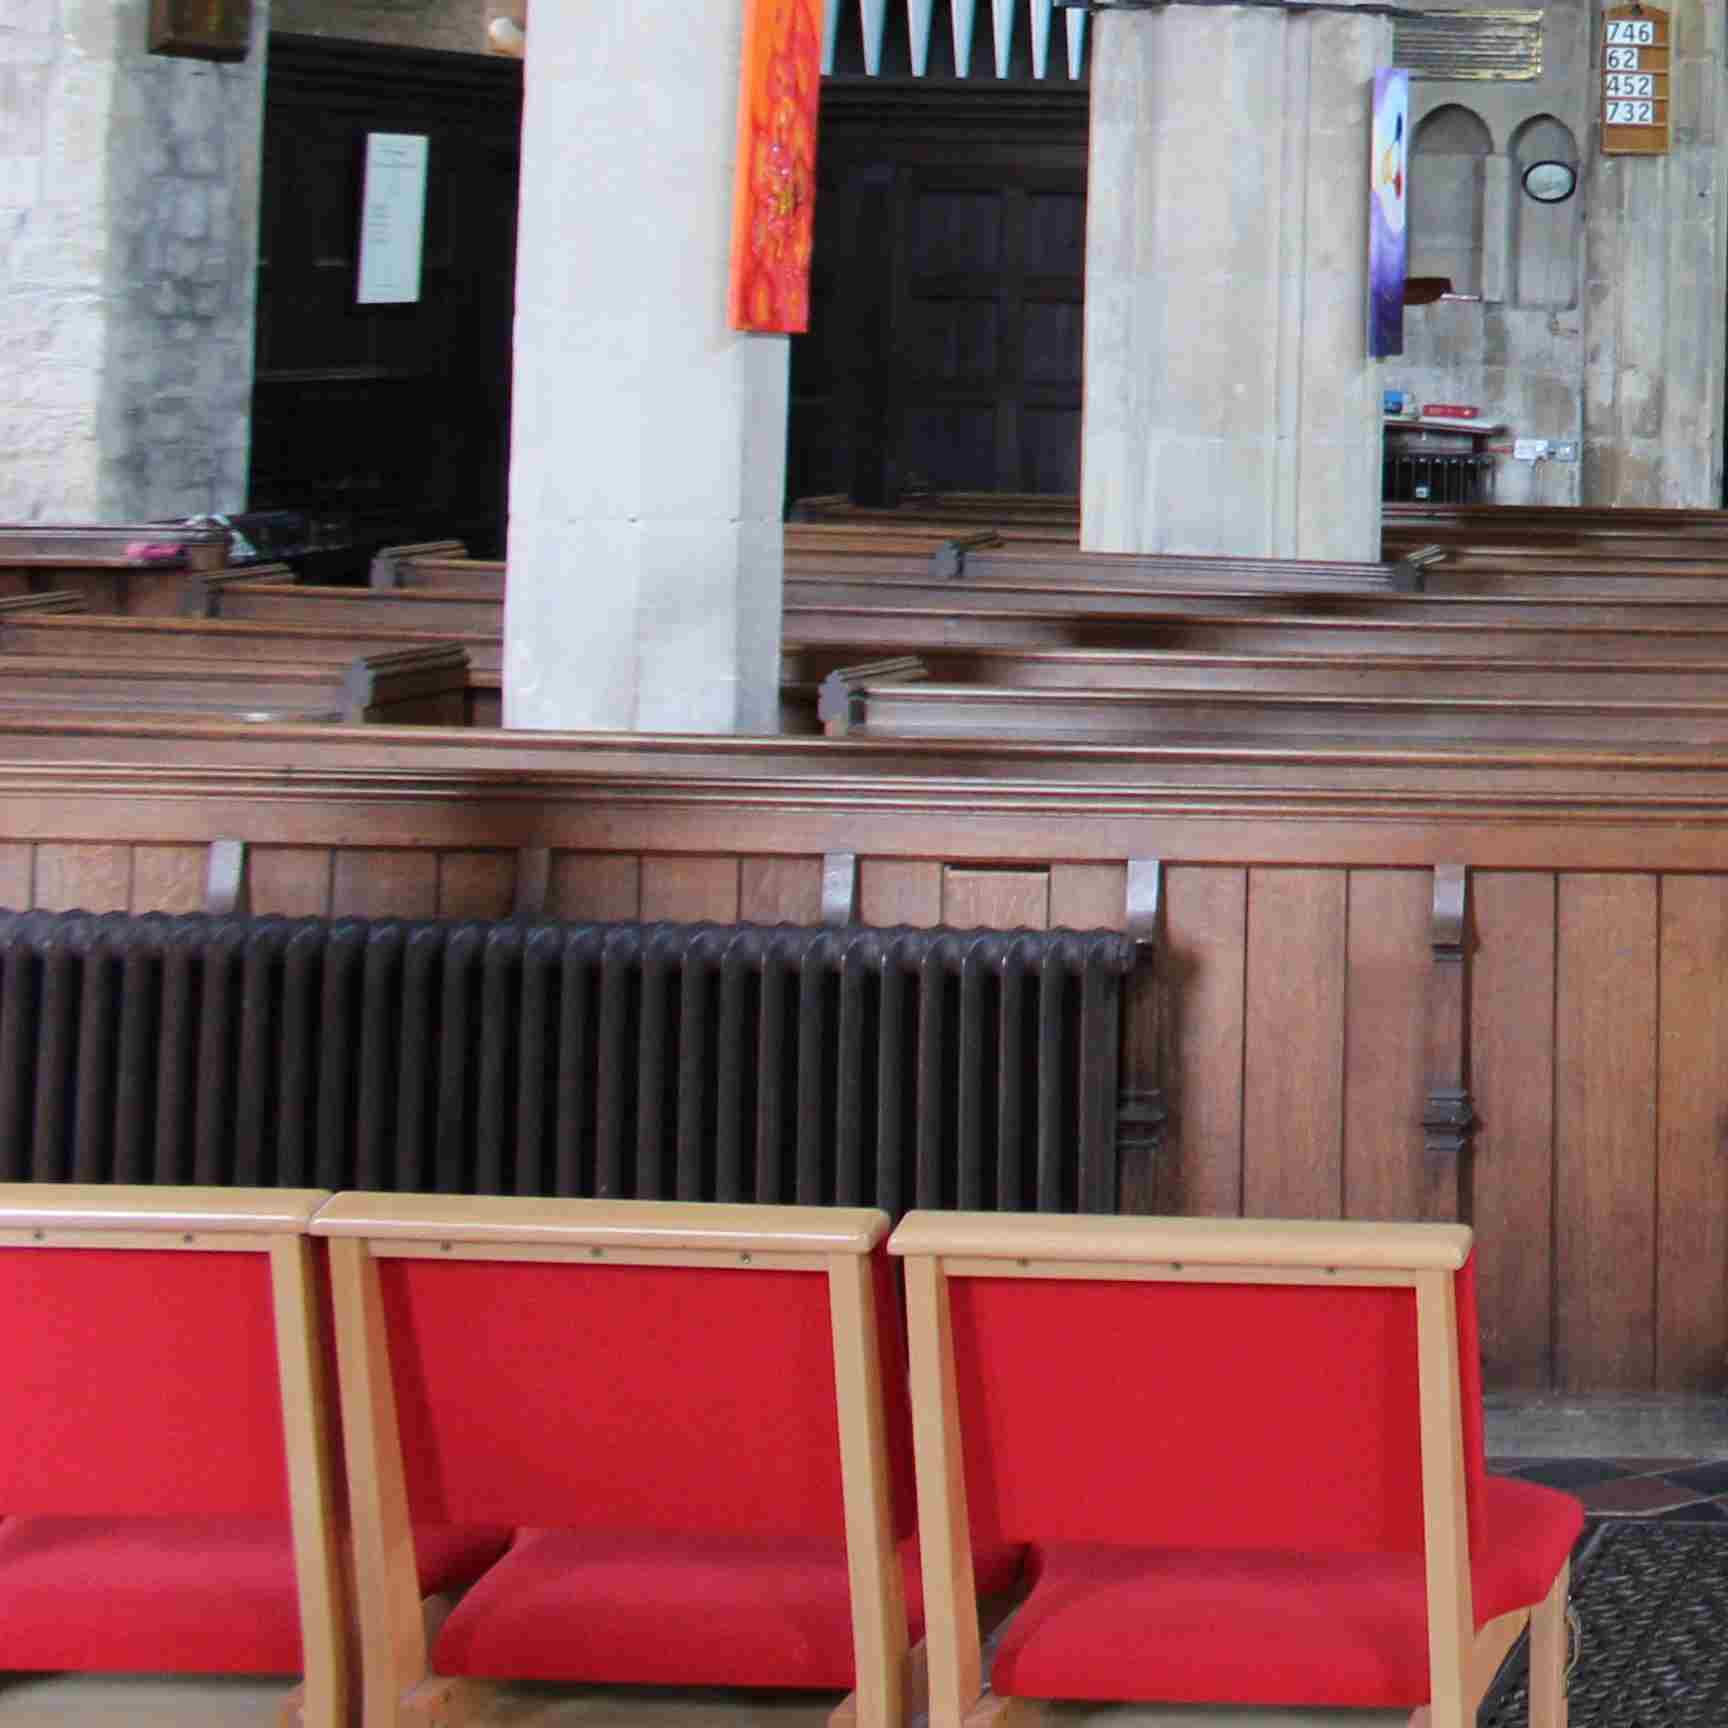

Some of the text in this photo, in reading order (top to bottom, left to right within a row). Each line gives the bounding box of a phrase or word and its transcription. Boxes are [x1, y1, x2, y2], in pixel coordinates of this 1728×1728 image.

[1607, 23, 1650, 42] 746
[1608, 49, 1635, 68] 62
[1607, 76, 1650, 95] 452
[1607, 102, 1650, 122] 732
